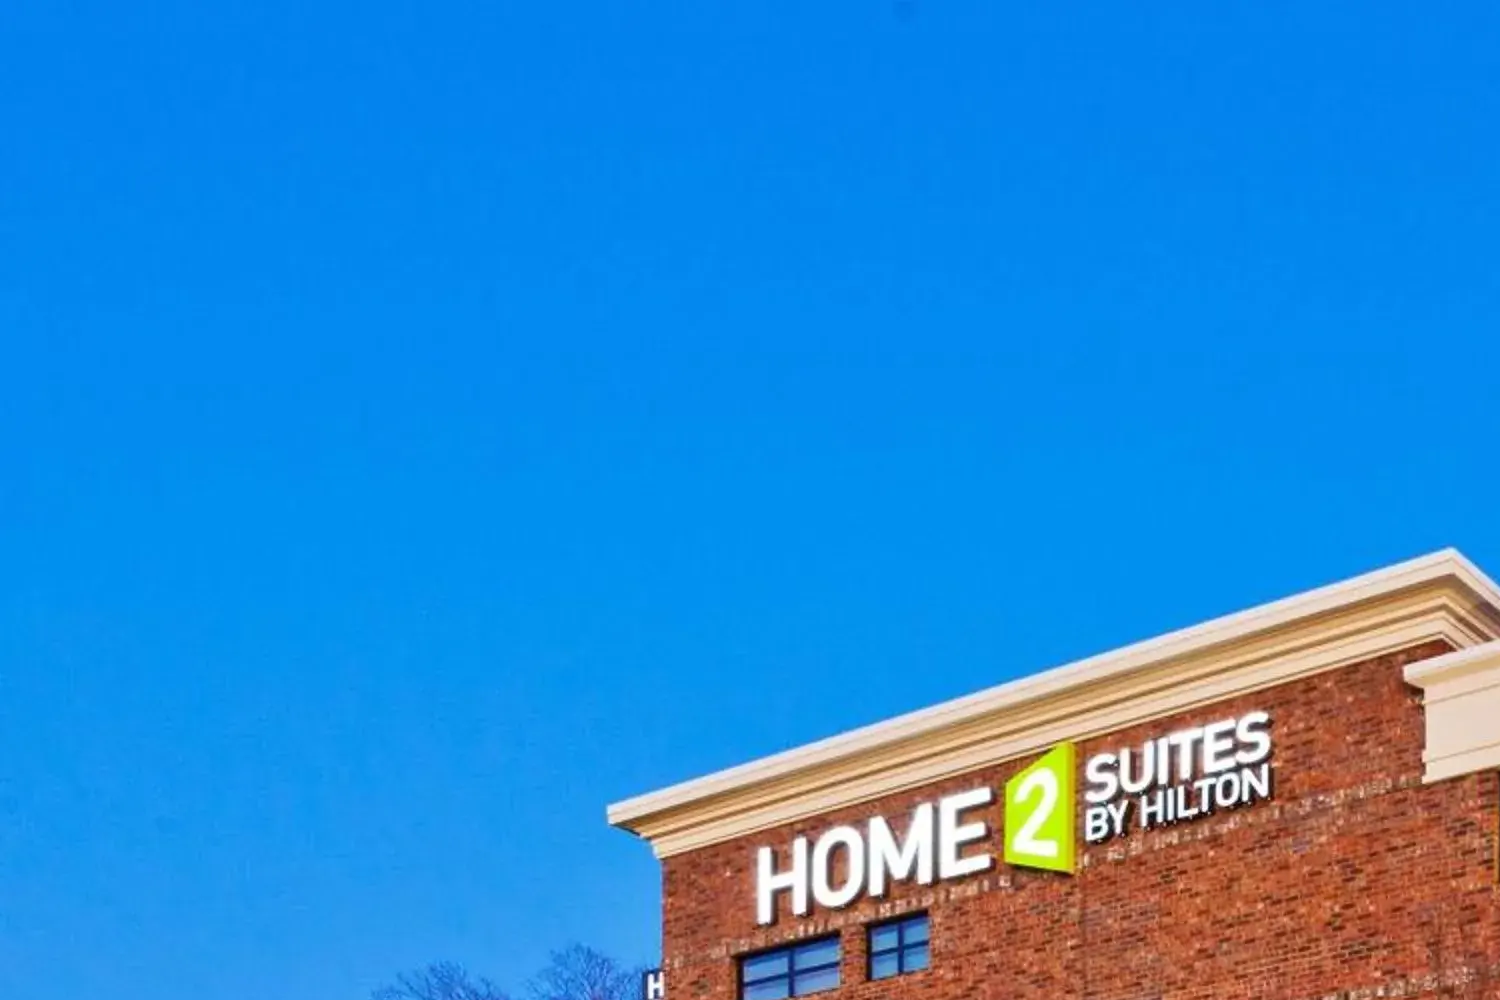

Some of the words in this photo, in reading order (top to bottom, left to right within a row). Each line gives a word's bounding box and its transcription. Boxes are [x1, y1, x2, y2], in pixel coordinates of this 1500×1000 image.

[756, 787, 992, 925] HOME
[1012, 767, 1059, 858] 2
[1084, 711, 1271, 803] SUITES
[1084, 800, 1129, 842] BY
[1139, 763, 1271, 828] HILTON
